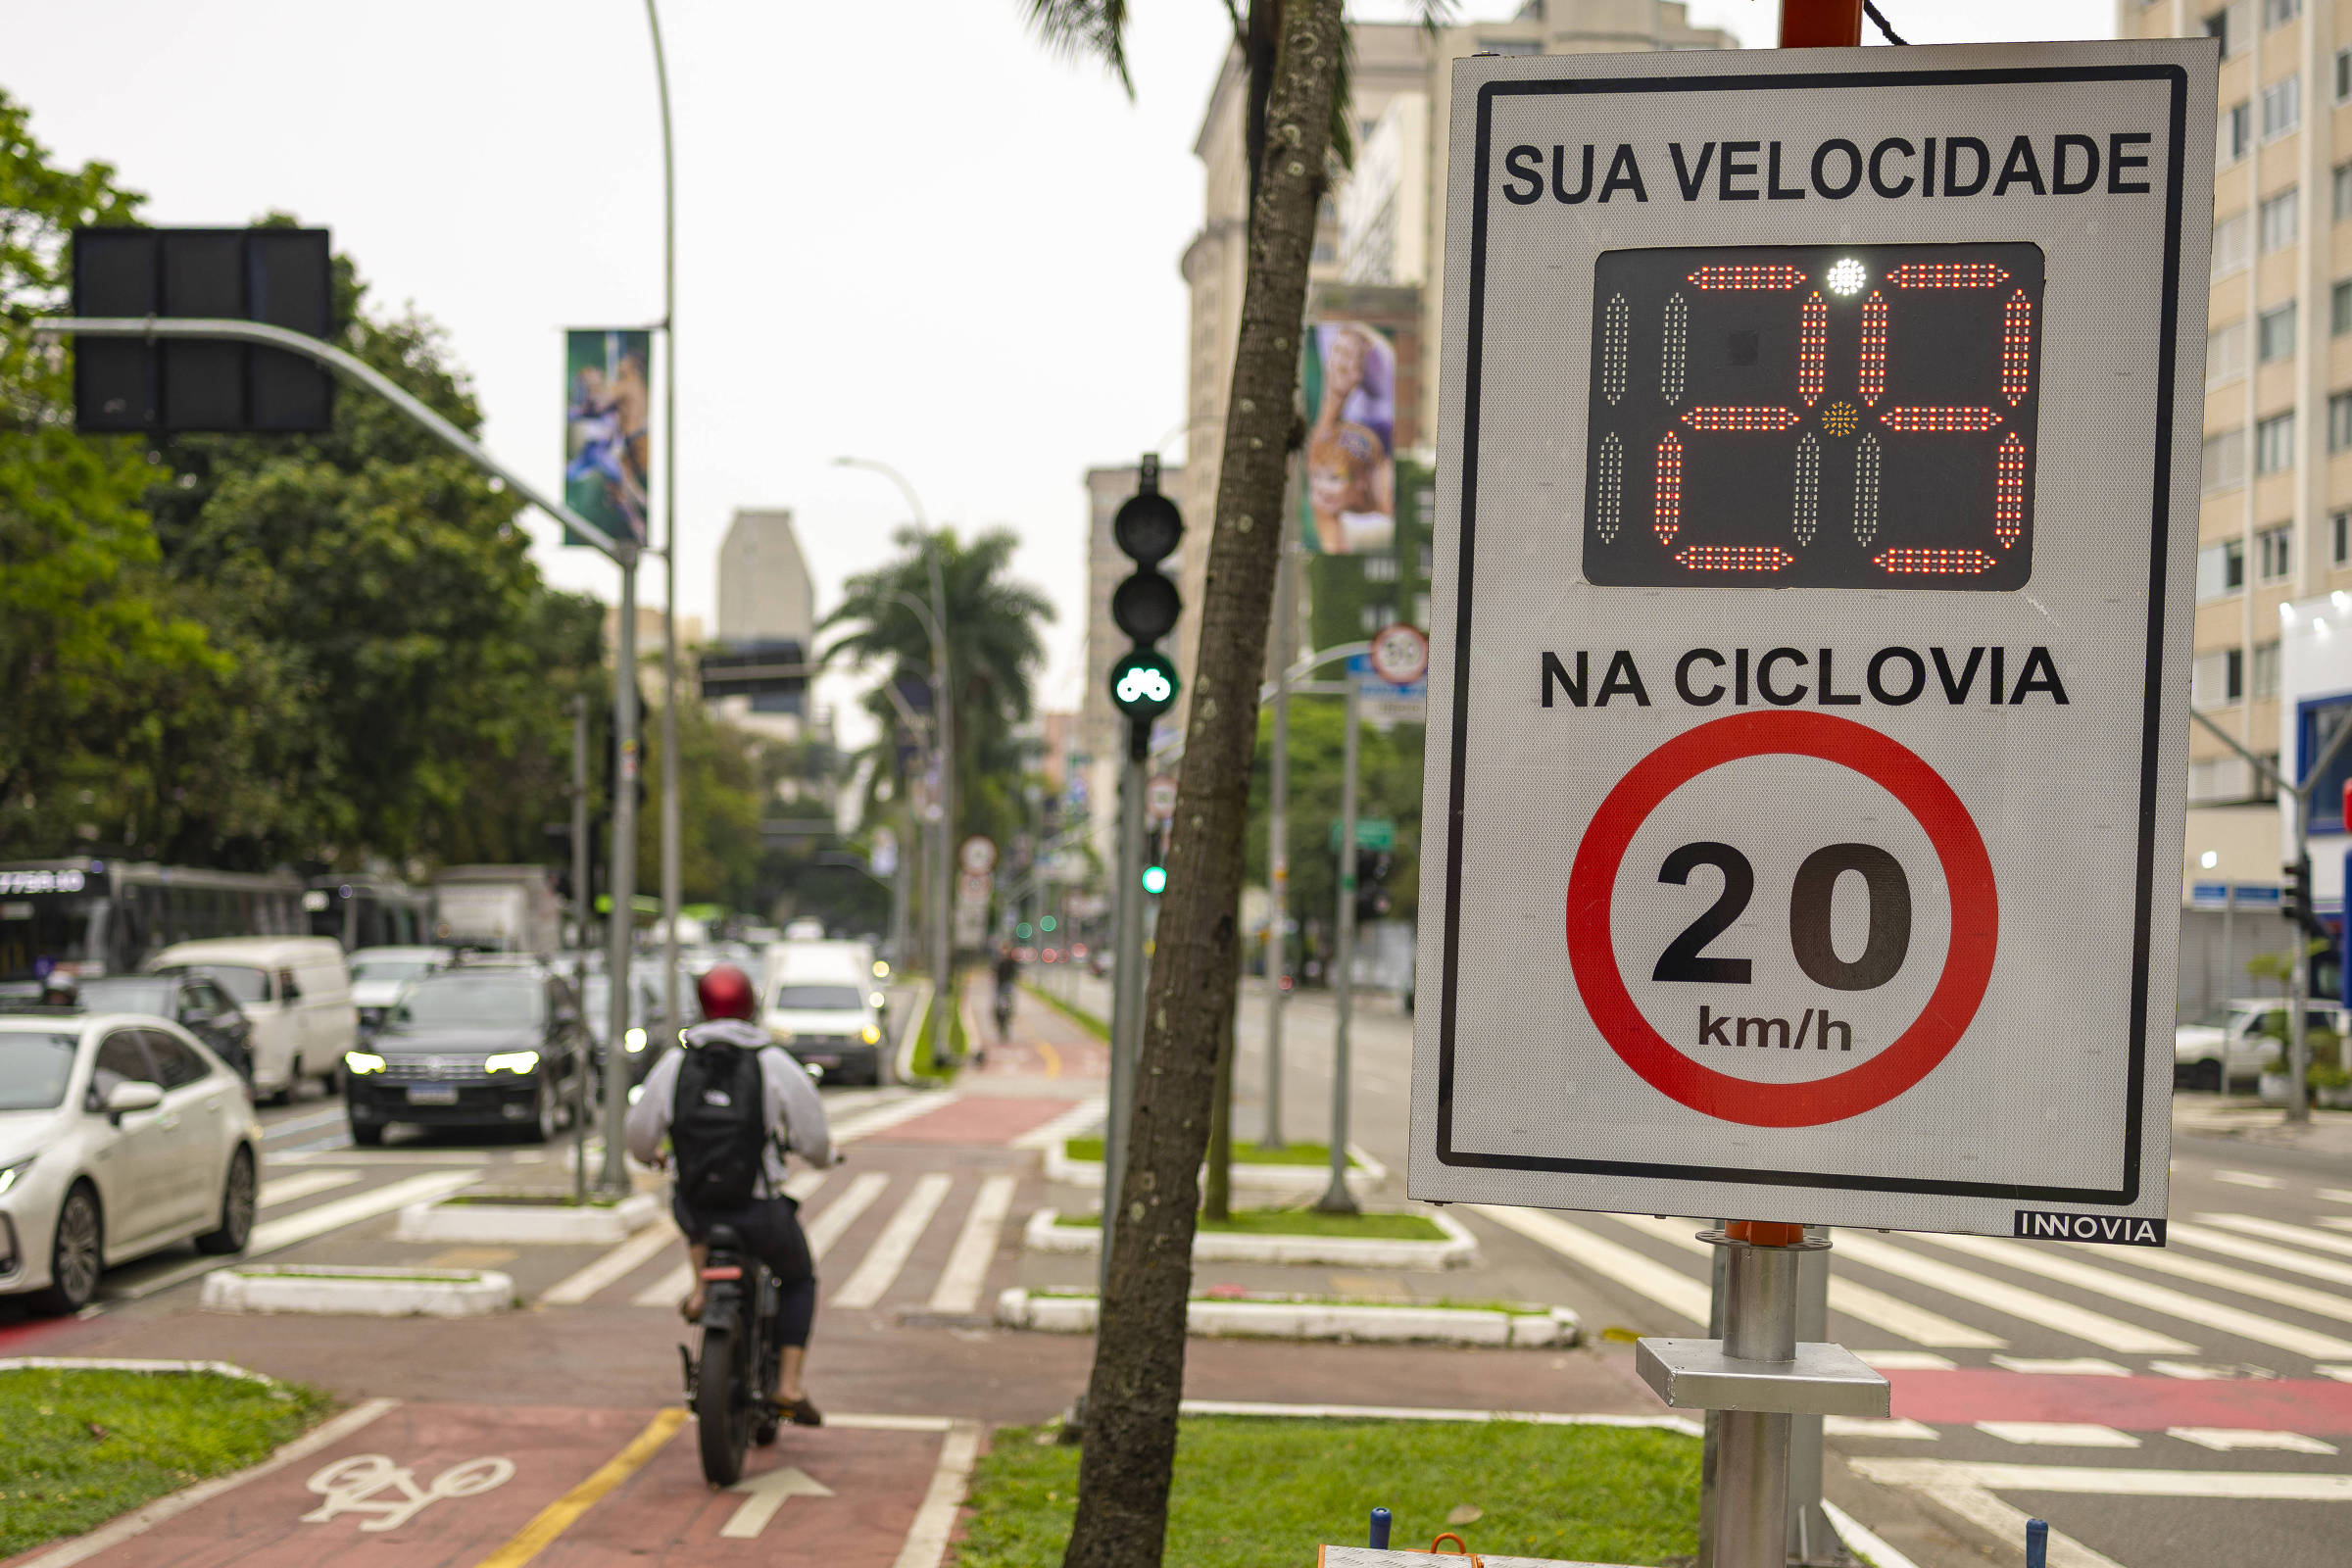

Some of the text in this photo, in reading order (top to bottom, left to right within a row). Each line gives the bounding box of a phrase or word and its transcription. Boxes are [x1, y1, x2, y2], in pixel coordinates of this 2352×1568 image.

[1504, 134, 2152, 206] SUA VELOCIDADE
[1654, 264, 2030, 572] 29
[1544, 648, 2069, 708] NA CICLOVIA
[1653, 843, 1912, 992] 20
[1700, 1006, 1852, 1052] km/h
[2022, 1213, 2157, 1243] INNOVIA
